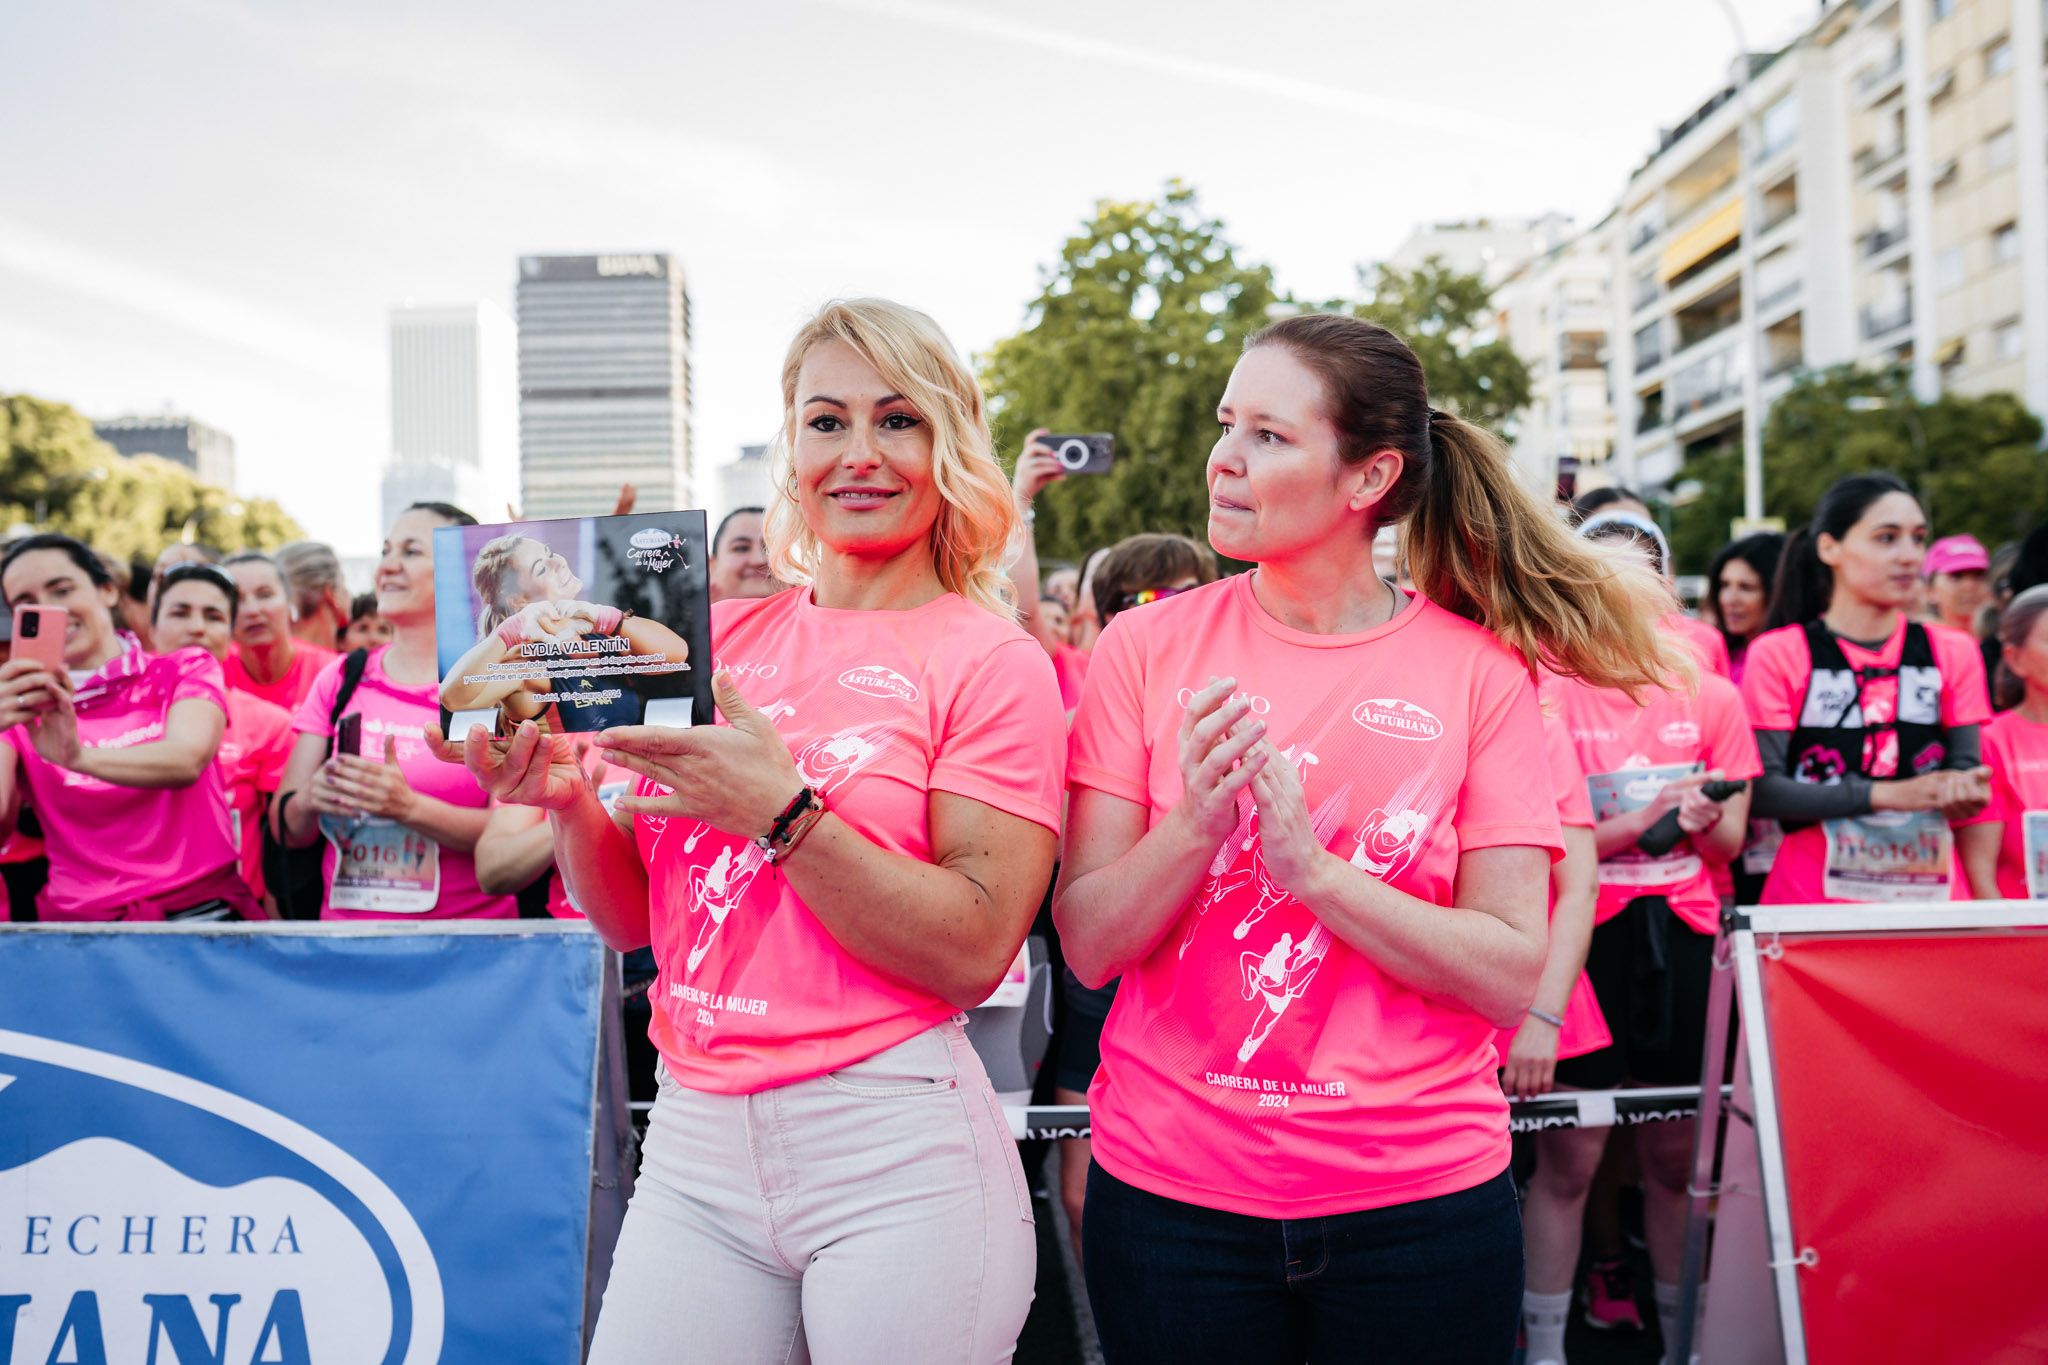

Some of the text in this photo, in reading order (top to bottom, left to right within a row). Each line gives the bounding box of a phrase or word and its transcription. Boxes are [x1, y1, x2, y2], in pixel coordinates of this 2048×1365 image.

[627, 548, 662, 558] Carrera
[647, 557, 674, 573] Mujer
[521, 636, 630, 657] LYDIA VALENTÍN
[501, 663, 526, 671] romper
[527, 661, 547, 669] todas
[547, 659, 558, 668] las
[559, 659, 589, 667] barreras
[600, 656, 608, 665] el
[609, 655, 636, 665] deporte
[637, 653, 665, 664] español
[464, 676, 470, 684] y
[507, 673, 517, 681] en
[518, 672, 531, 680] una
[532, 671, 542, 679] de
[543, 670, 554, 678] las
[554, 669, 583, 679] mejores
[584, 666, 623, 677] deportistas
[624, 665, 633, 674] de
[634, 664, 660, 674] nuestra
[533, 689, 621, 702] Madrid, 12 de mayo 2024
[1359, 706, 1436, 735] ASTURIANA
[709, 994, 723, 1010] LA
[726, 996, 768, 1016] MUJER
[696, 1008, 714, 1027] 2024
[1205, 1072, 1346, 1096] CARRERA DE LA MUJER
[1258, 1094, 1290, 1108] 2024
[0, 1214, 303, 1256] ECHERA
